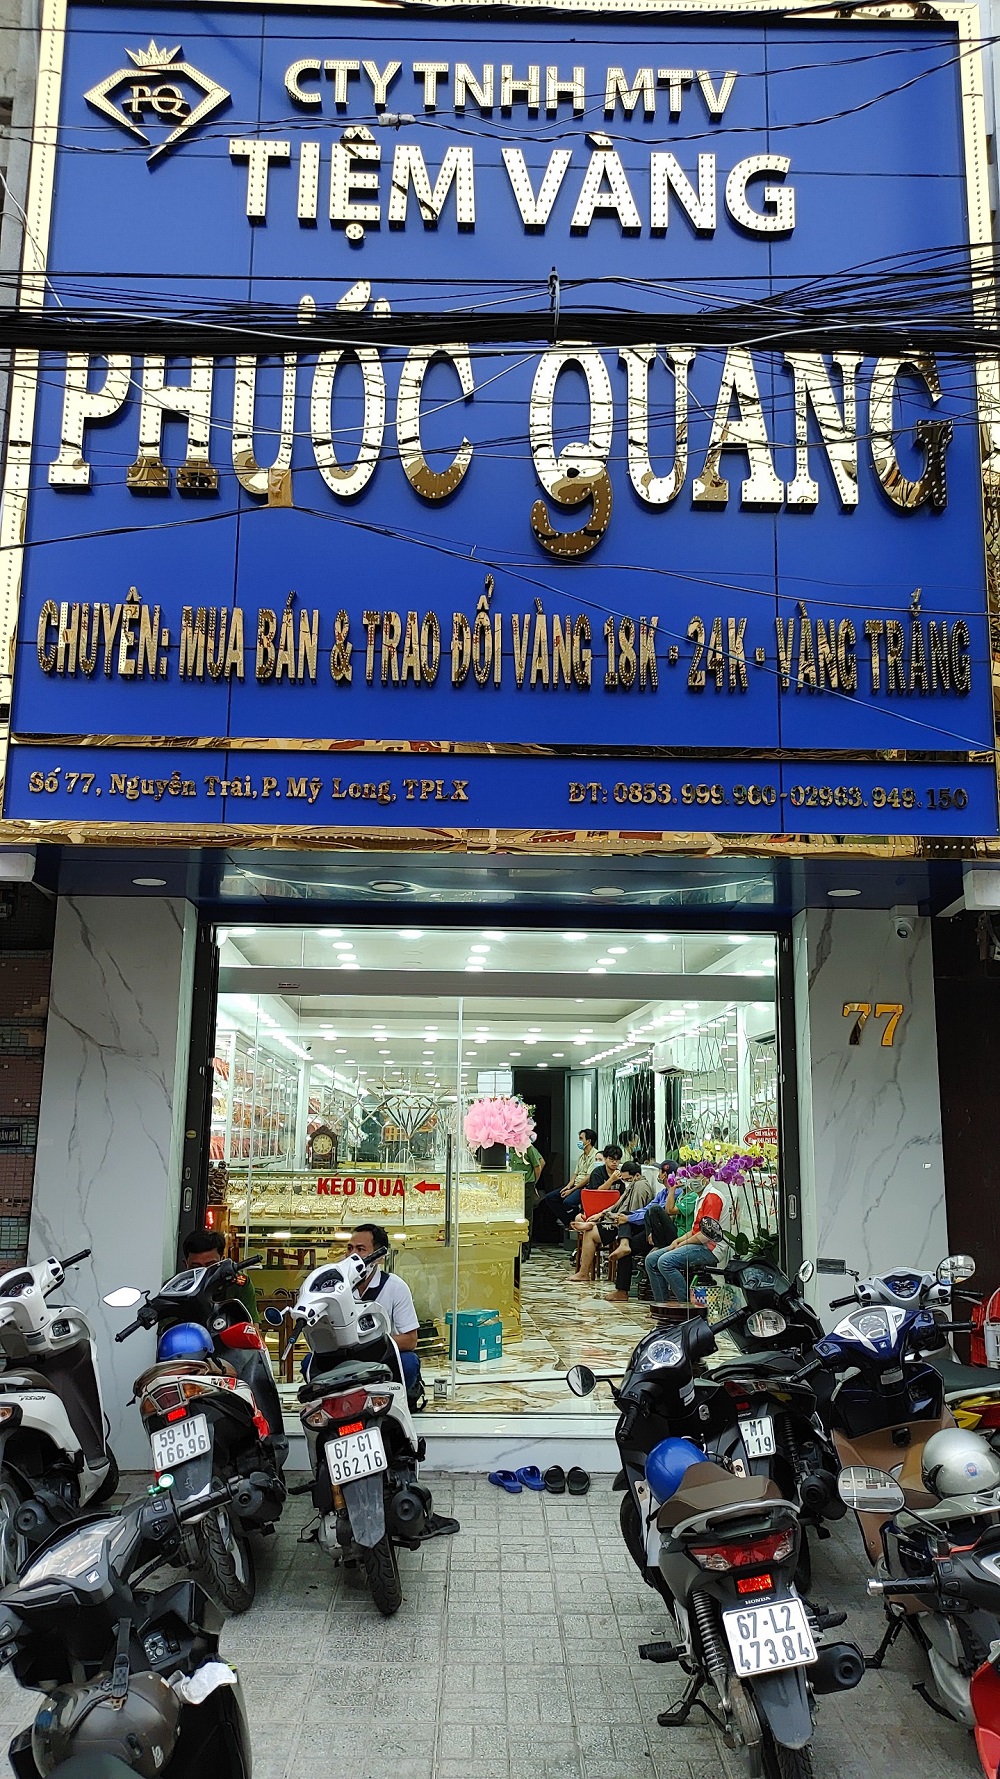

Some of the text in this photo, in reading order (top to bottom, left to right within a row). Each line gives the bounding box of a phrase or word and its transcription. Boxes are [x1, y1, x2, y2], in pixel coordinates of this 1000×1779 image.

[127, 84, 189, 119] PQ
[284, 59, 738, 114] CTY TNHH MTV
[229, 126, 795, 240] TIỆM VÀNG
[48, 281, 954, 557] PHƯỚC QUANG
[37, 586, 170, 677] CHUYÊN:
[178, 605, 244, 678] MUA
[255, 590, 319, 681] BÁN
[330, 609, 352, 682] &
[363, 610, 441, 683] TRAO
[451, 573, 502, 684] ĐỔI
[511, 597, 592, 686] VÀNG
[604, 615, 659, 688] 18K
[686, 615, 748, 688] 24K
[775, 601, 858, 690] VÀNG
[865, 587, 971, 692] TRẮNG
[28, 767, 61, 793] Số
[65, 772, 102, 797] 77,
[402, 779, 469, 801] TPLX
[842, 1002, 904, 1046] 77
[317, 1172, 405, 1198] KÉO QUA
[157, 1435, 206, 1467] 166.96
[160, 1420, 197, 1448] 59-U1
[334, 1433, 372, 1460] 67-G1
[333, 1450, 383, 1481] 362.16
[744, 1596, 771, 1605] HONDA
[736, 1605, 796, 1640] 67-L2
[738, 1632, 810, 1670] 473.84
